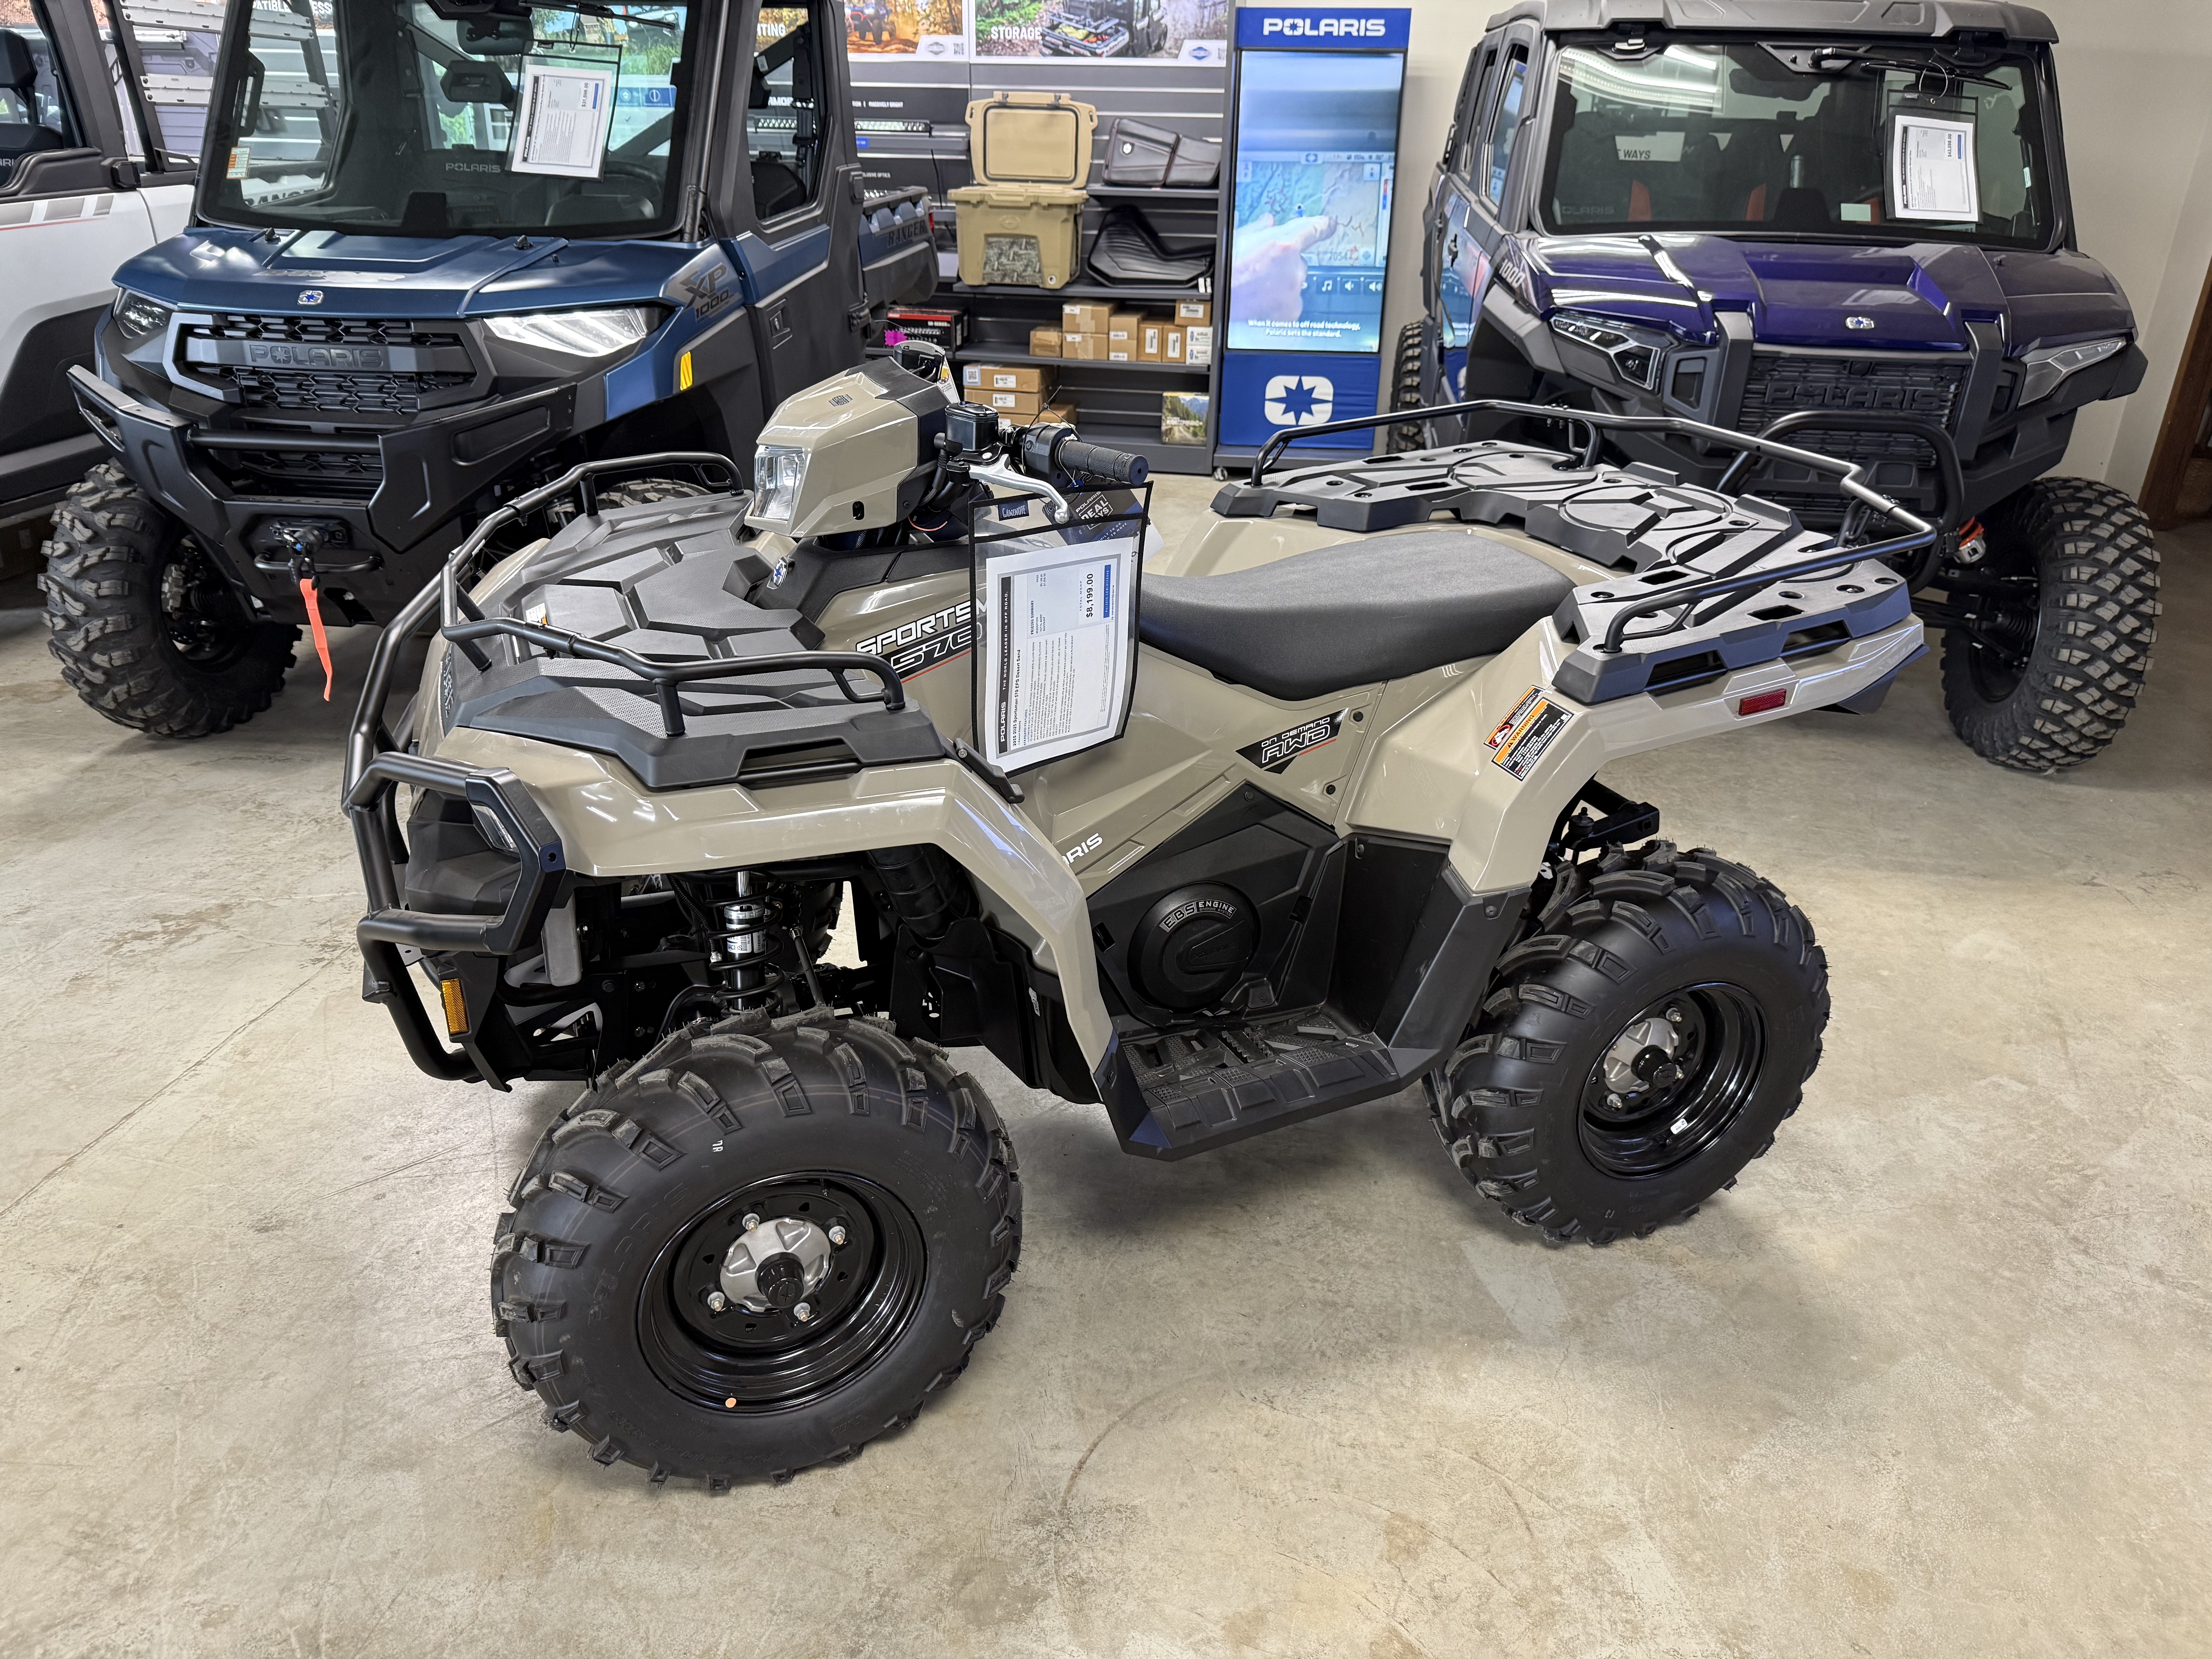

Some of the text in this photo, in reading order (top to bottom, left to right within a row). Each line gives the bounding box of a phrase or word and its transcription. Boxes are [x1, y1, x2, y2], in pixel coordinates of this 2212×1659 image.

[991, 26, 1042, 40] STORAGE
[1263, 18, 1385, 36] POLARIS
[446, 162, 500, 173] POLARIS
[1623, 149, 1650, 160] WAYS
[696, 289, 729, 319] 1000
[249, 343, 384, 368] POLARIS
[1766, 381, 1941, 410] POLARIS
[1261, 717, 1330, 748] ON DEMAND
[1511, 714, 1535, 744] WARNING
[1261, 724, 1331, 764] AWD
[1163, 901, 1235, 929] EBS ENGINE
